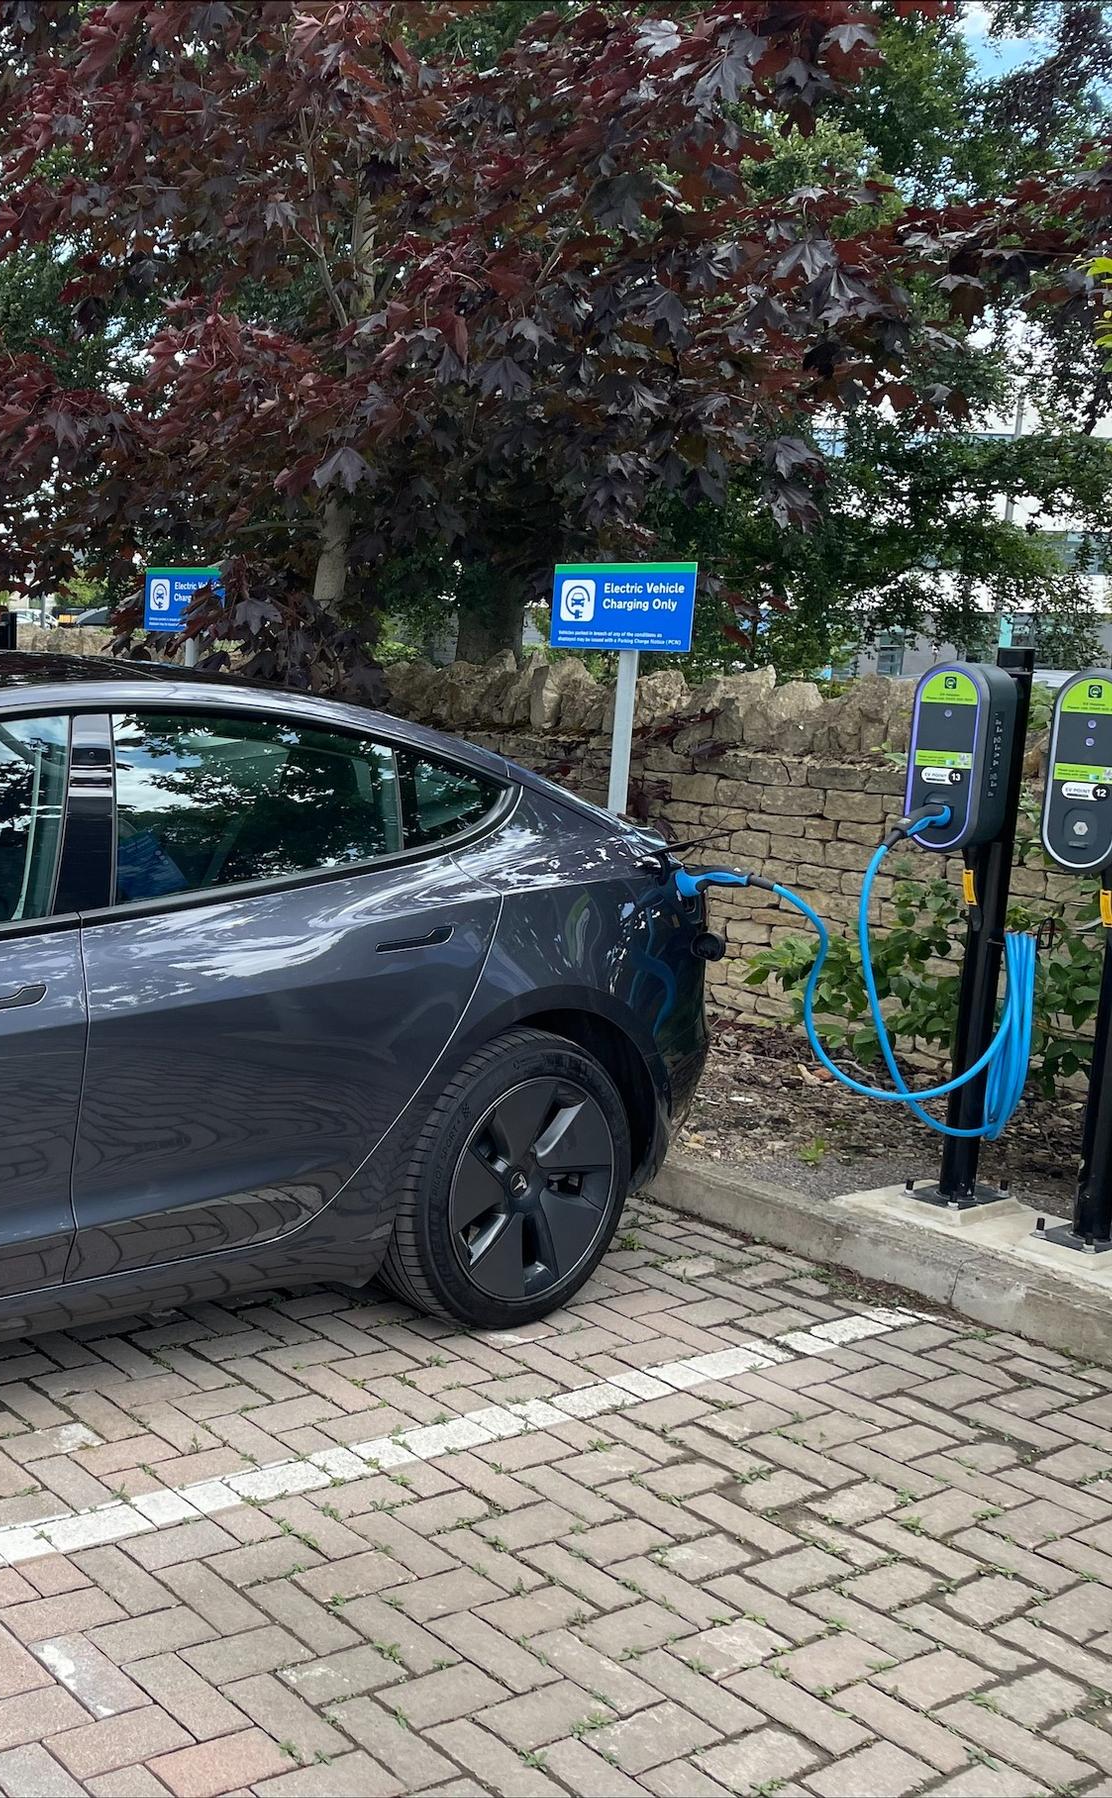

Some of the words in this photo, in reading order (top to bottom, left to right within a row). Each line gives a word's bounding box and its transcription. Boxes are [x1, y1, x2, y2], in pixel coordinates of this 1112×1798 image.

[175, 582, 197, 590] Electric
[604, 582, 643, 594] Electric
[646, 582, 685, 594] Vehicle
[174, 594, 192, 603] Charg
[602, 598, 649, 612] Charging
[652, 598, 678, 612] Only
[951, 773, 961, 782] 13
[1096, 788, 1107, 798] 12
